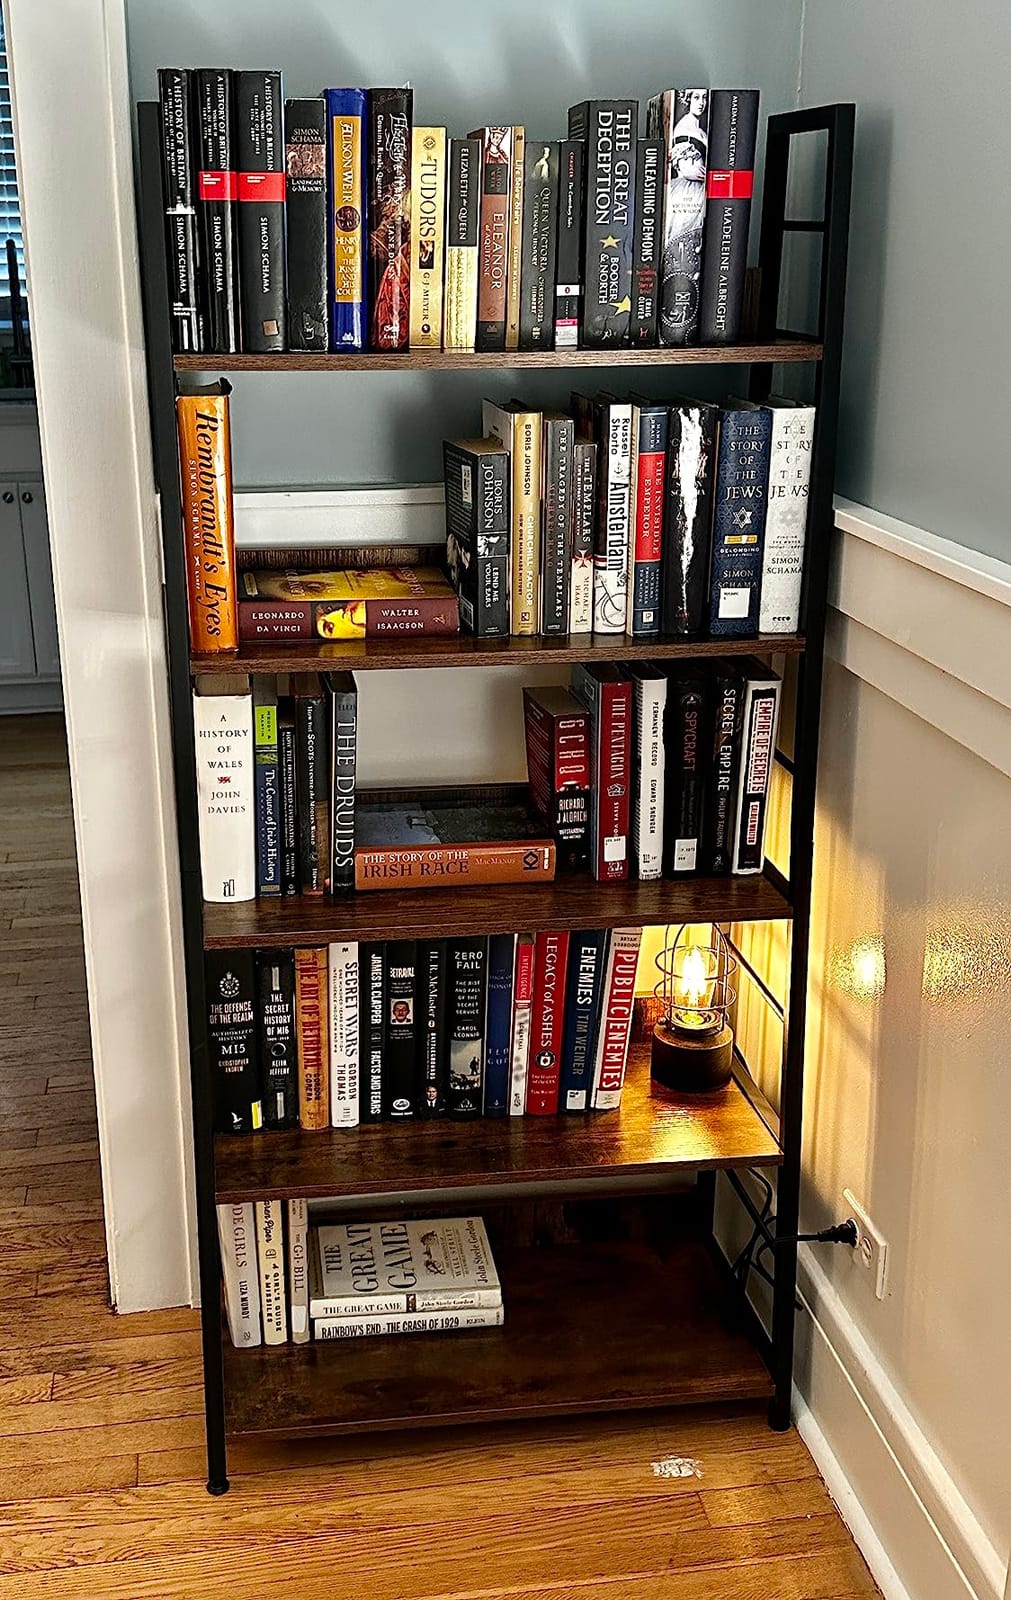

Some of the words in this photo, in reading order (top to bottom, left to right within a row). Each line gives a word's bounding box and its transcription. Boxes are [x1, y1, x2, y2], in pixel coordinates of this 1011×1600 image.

[174, 86, 183, 130] HISTORY
[217, 84, 226, 120] HISTORY
[265, 86, 273, 121] HISTORY
[176, 132, 184, 145] OF
[218, 122, 226, 134] OF
[266, 123, 273, 134] OF
[293, 128, 319, 136] SIMON
[340, 120, 353, 169] ALISON
[616, 110, 631, 151] THE
[177, 149, 186, 188] BRITAIN
[219, 136, 227, 169] BRITAIN
[266, 137, 274, 170] BRITAIN
[596, 111, 613, 224] DECEPTION
[342, 170, 353, 202] WEIR
[460, 148, 469, 197] ELIZABETH
[643, 148, 658, 214] UNLEASHING
[420, 159, 437, 238] TUDORS
[541, 188, 551, 222] QUEEN
[614, 160, 629, 225] GREAT
[177, 217, 185, 250] SIMON
[214, 216, 222, 249] SIMON
[260, 217, 268, 250] SIMON
[459, 207, 468, 240] QUEEN
[641, 218, 655, 261] DEMONS
[721, 207, 732, 271] MADELEINE
[388, 252, 396, 280] DUNN
[492, 214, 504, 289] ELEANOR
[539, 226, 549, 272] VICTORIA
[600, 253, 609, 263] &
[178, 253, 187, 293] SCHAMA
[214, 252, 223, 292] SCHAMA
[261, 254, 270, 293] SCHAMA
[599, 266, 609, 304] NORTH
[609, 257, 619, 301] BOOKER
[716, 274, 728, 330] ALBRIGHT
[611, 418, 620, 455] Shorto
[621, 418, 630, 457] Russell
[729, 441, 765, 452] STORY
[737, 426, 760, 435] THE
[736, 471, 757, 480] THE
[739, 456, 754, 465] OF
[189, 460, 198, 496] SIMON
[196, 409, 225, 574] Rembrandt's
[559, 457, 567, 509] TRAGEDY
[726, 486, 763, 501] JEWS
[482, 464, 494, 528] JOHNSON
[494, 480, 502, 514] BORIS
[583, 475, 592, 542] TEMPLARS
[643, 479, 651, 538] EMPEROR
[192, 502, 200, 546] SCHAMA
[558, 514, 564, 528] OF
[608, 482, 628, 571] Amsterdam
[196, 580, 227, 636] Eyes
[493, 590, 499, 602] ME
[377, 622, 424, 630] ISAACSON
[220, 714, 227, 722] A
[612, 697, 626, 718] THE
[722, 689, 736, 736] SECRET
[199, 729, 248, 738] HISTORY
[337, 717, 356, 767] THE
[610, 722, 625, 778] PENTAGON
[683, 711, 698, 771] SPYCRAFT
[265, 770, 275, 786] The
[718, 745, 732, 791] EMPIRE
[207, 806, 246, 814] DAVIES
[211, 791, 241, 800] JOHN
[266, 788, 276, 815] Course
[265, 816, 276, 827] of
[266, 827, 276, 846] Irish
[335, 775, 355, 866] DRUIDS
[265, 848, 277, 882] History
[363, 855, 386, 864] THE
[389, 852, 424, 862] STORY
[428, 852, 443, 861] OF
[447, 851, 469, 860] THE
[363, 864, 412, 878] IRISH
[420, 861, 469, 876] RACE
[371, 954, 382, 981] JAMES
[454, 951, 482, 960] ZERO
[544, 937, 558, 990] LEGACY
[345, 962, 357, 1008] SECRET
[371, 982, 382, 990] R.
[577, 947, 597, 1004] ENEMIES
[611, 954, 636, 1014] PUBLIC
[211, 1004, 223, 1014] THE
[225, 1001, 252, 1013] DEFENCE
[265, 1004, 289, 1014] SECRET
[271, 994, 283, 1002] THE
[371, 990, 382, 1024] CLAPPER
[544, 992, 554, 1004] of
[210, 1014, 217, 1024] OF
[220, 1014, 231, 1024] THE
[233, 1011, 254, 1023] REALM
[264, 1015, 291, 1025] HISTORY
[541, 1005, 553, 1047] ASHES
[576, 1015, 589, 1032] TIM
[221, 1044, 245, 1055] MI5
[345, 1014, 358, 1057] WARS
[371, 1051, 381, 1076] FACTS
[572, 1037, 586, 1075] WEINER
[602, 1023, 627, 1088] ENEMIES
[337, 1064, 346, 1101] THOMAS
[348, 1063, 356, 1100] GORDON
[371, 1077, 381, 1090] AND
[371, 1091, 381, 1114] FEARS
[234, 1227, 248, 1268] GIRLS
[324, 1244, 342, 1274] THE
[346, 1225, 379, 1293] GREAT
[380, 1224, 417, 1289] GAME
[239, 1280, 248, 1297] LIZA
[240, 1297, 249, 1320] MUNDY
[323, 1306, 342, 1314] THE
[344, 1305, 374, 1313] GREAT
[322, 1325, 364, 1338] RAINBOW'S
[366, 1323, 381, 1334] END
[386, 1322, 400, 1333] THE
[403, 1319, 426, 1331] CRASH
[429, 1319, 438, 1328] OF
[441, 1317, 460, 1328] 1929
